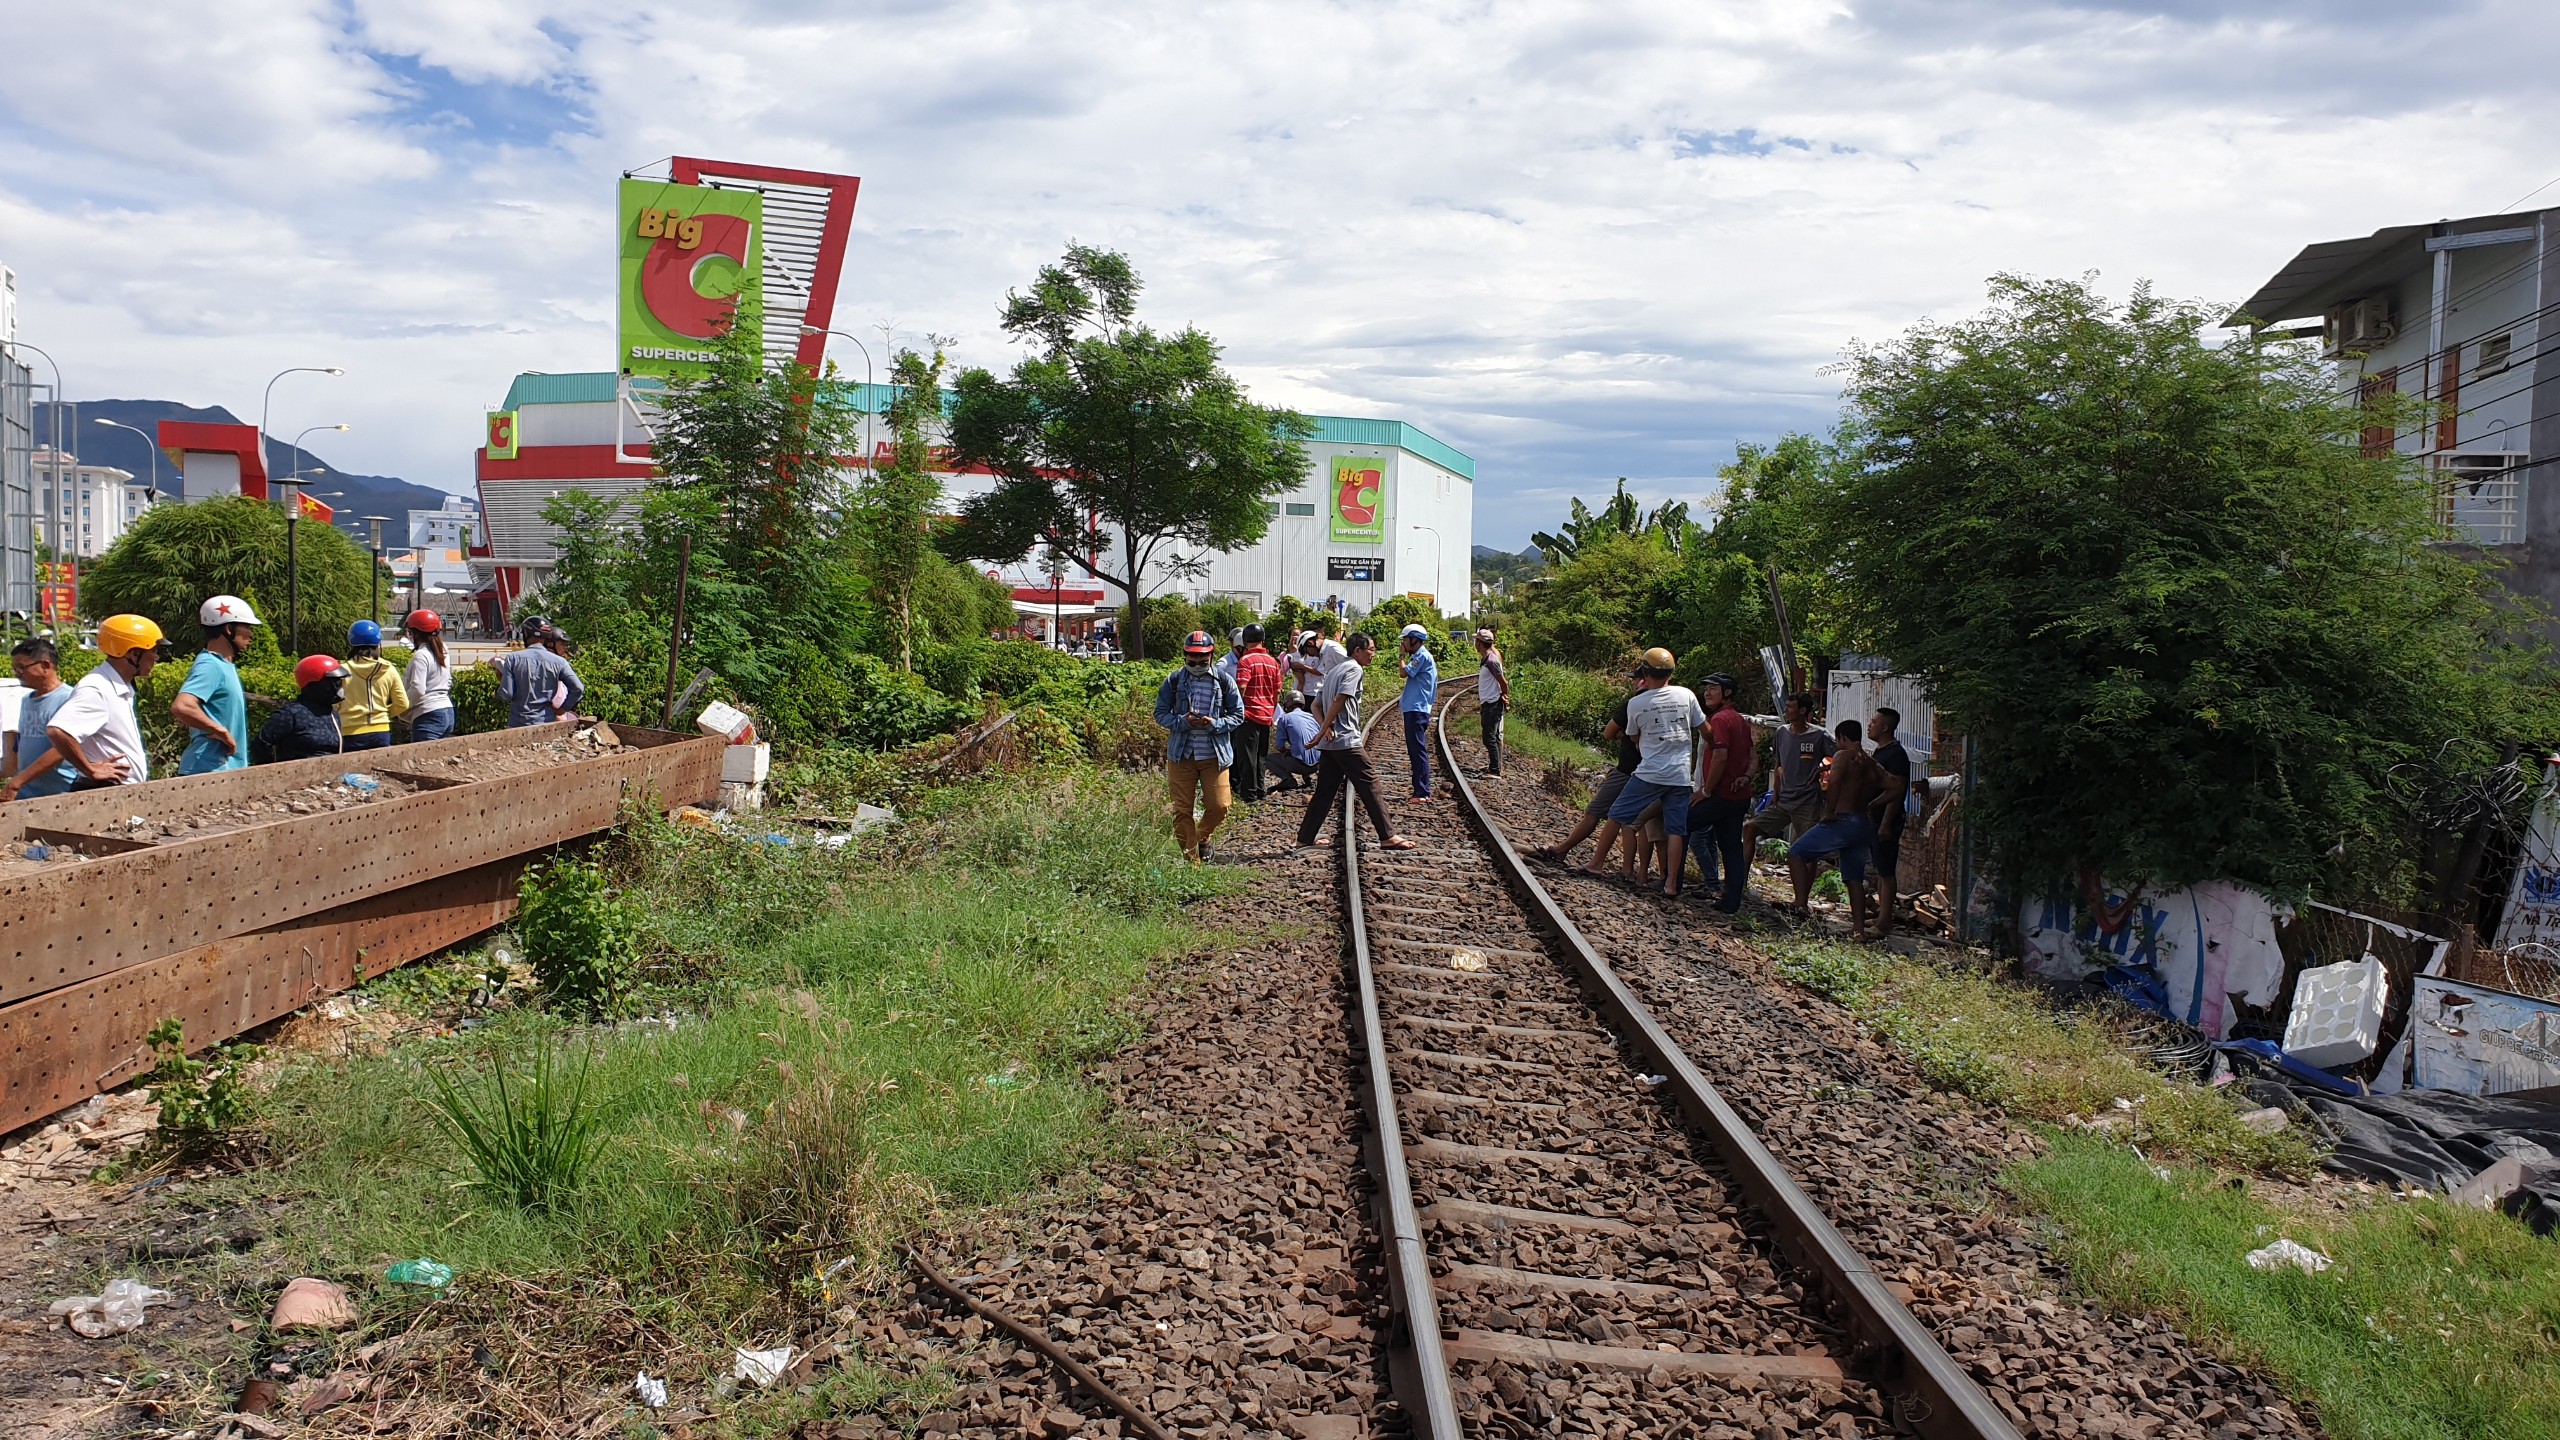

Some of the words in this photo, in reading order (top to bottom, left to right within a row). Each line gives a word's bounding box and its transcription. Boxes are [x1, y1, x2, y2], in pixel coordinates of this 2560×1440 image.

[638, 208, 704, 250] Big
[642, 214, 752, 341] C
[1338, 468, 1364, 487] Big
[1339, 469, 1382, 526] C
[1800, 742, 1814, 752] GER
